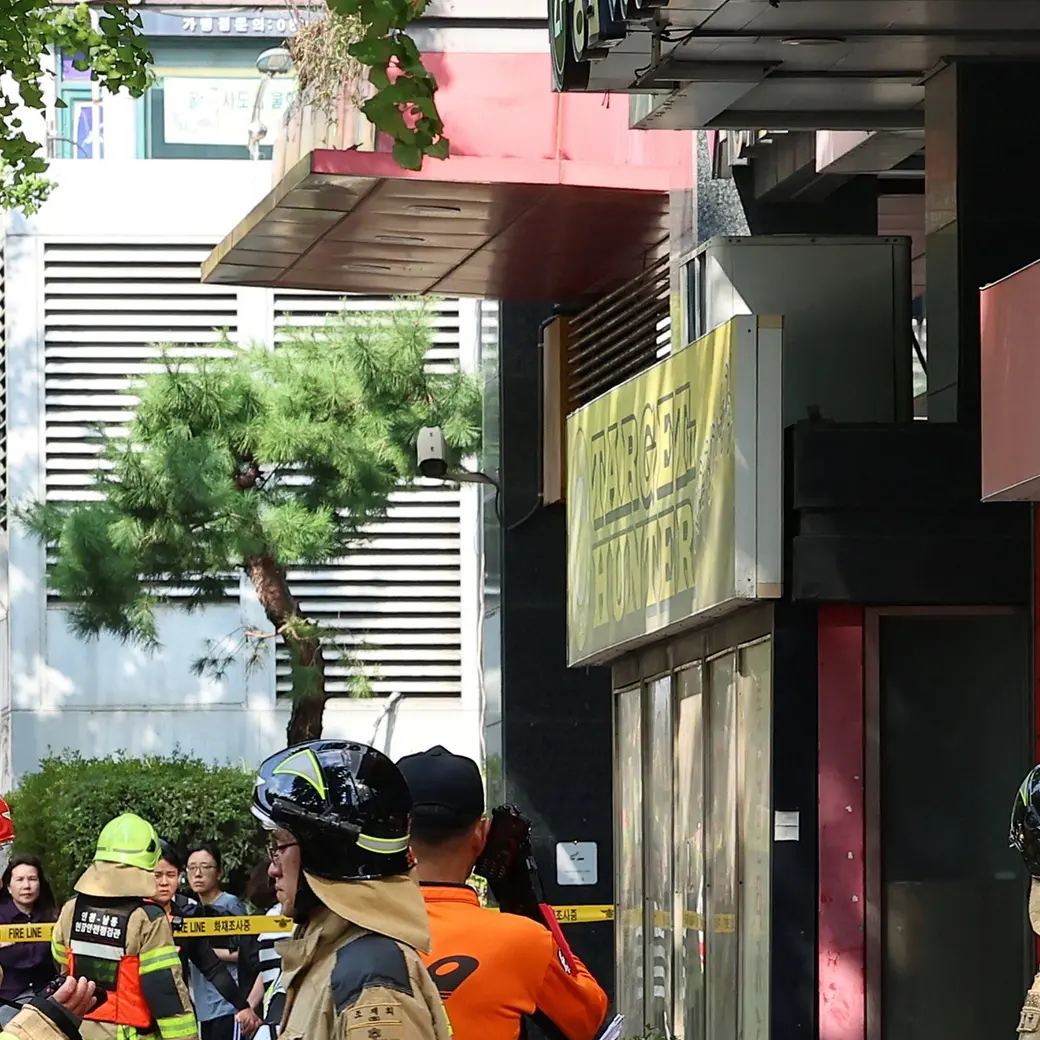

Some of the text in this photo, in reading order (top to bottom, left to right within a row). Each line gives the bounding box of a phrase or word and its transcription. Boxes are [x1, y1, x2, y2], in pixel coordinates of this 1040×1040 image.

[591, 500, 695, 628] HUNTER
[555, 908, 577, 921] 조사중
[190, 921, 206, 932] LINE
[214, 919, 251, 932] 화재조사중
[8, 927, 42, 939] FIRE LINE
